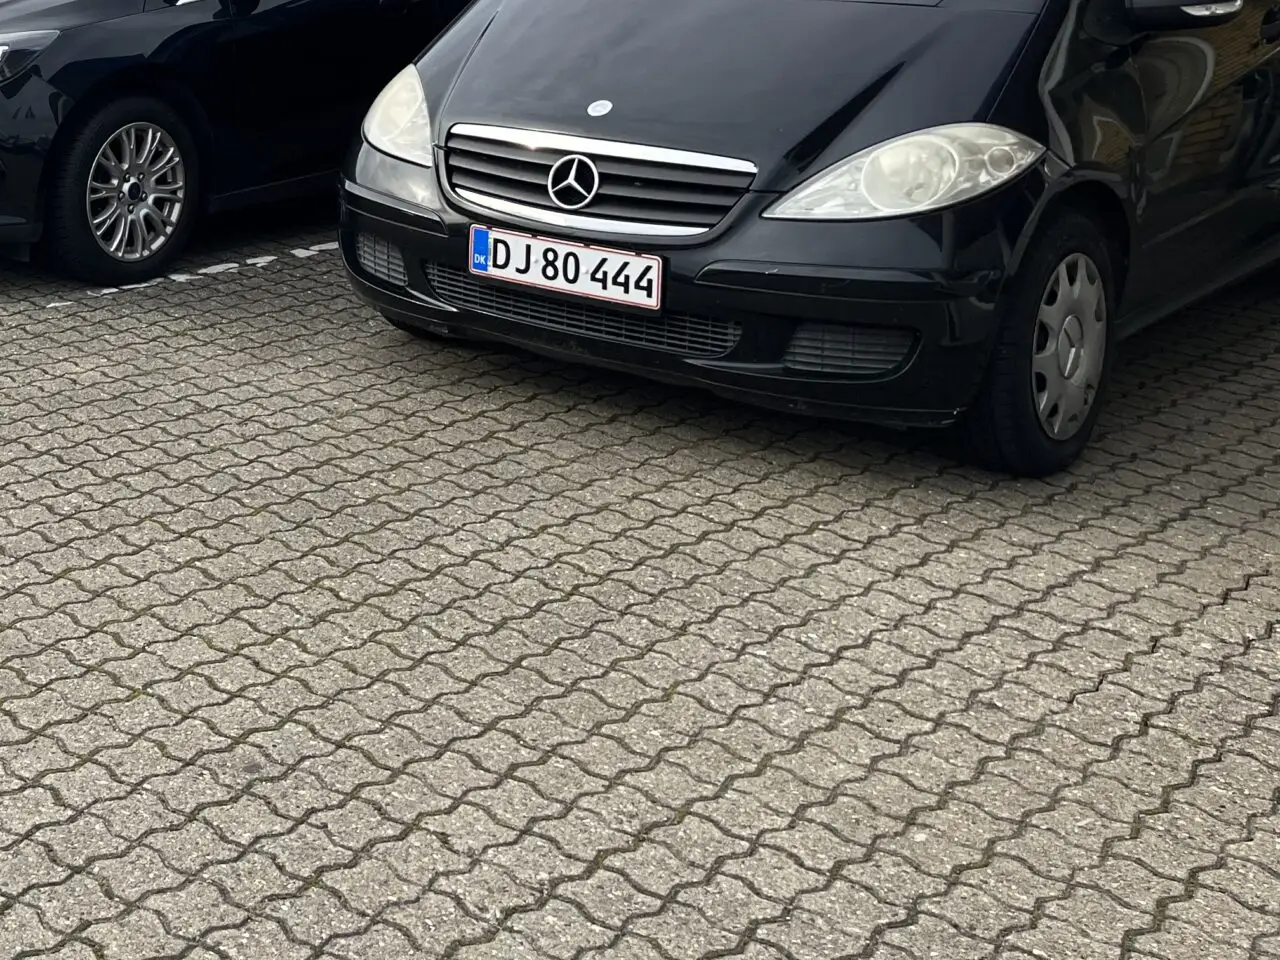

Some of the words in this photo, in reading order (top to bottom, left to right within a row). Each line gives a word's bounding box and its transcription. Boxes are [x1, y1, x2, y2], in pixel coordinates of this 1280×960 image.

[474, 253, 487, 265] DK
[492, 237, 531, 274] DJ
[541, 247, 580, 284] 80
[590, 257, 653, 299] 444
